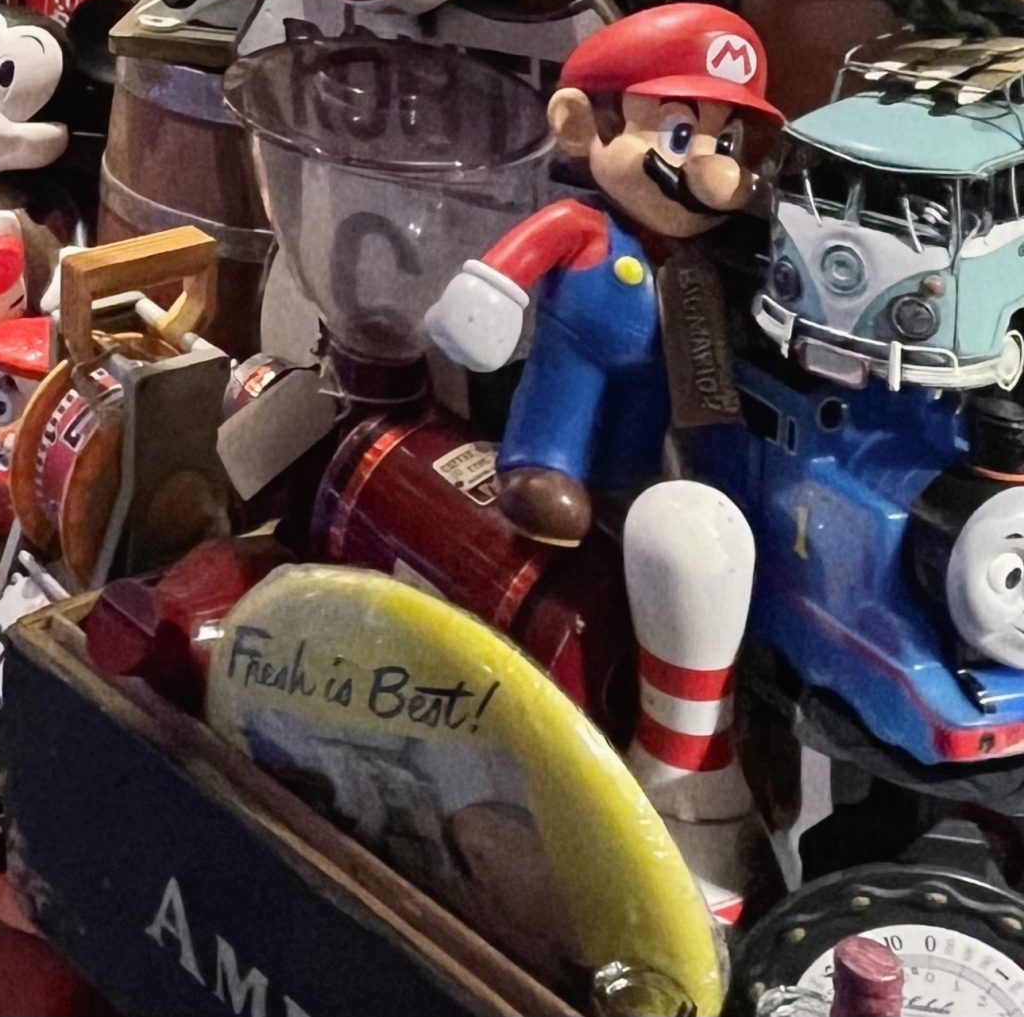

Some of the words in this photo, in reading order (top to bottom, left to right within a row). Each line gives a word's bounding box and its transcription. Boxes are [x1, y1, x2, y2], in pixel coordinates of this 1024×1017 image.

[711, 40, 752, 76] M
[228, 625, 317, 697] Fresh
[325, 656, 354, 708] is
[367, 666, 502, 734] Best!
[144, 876, 312, 1017] AM
